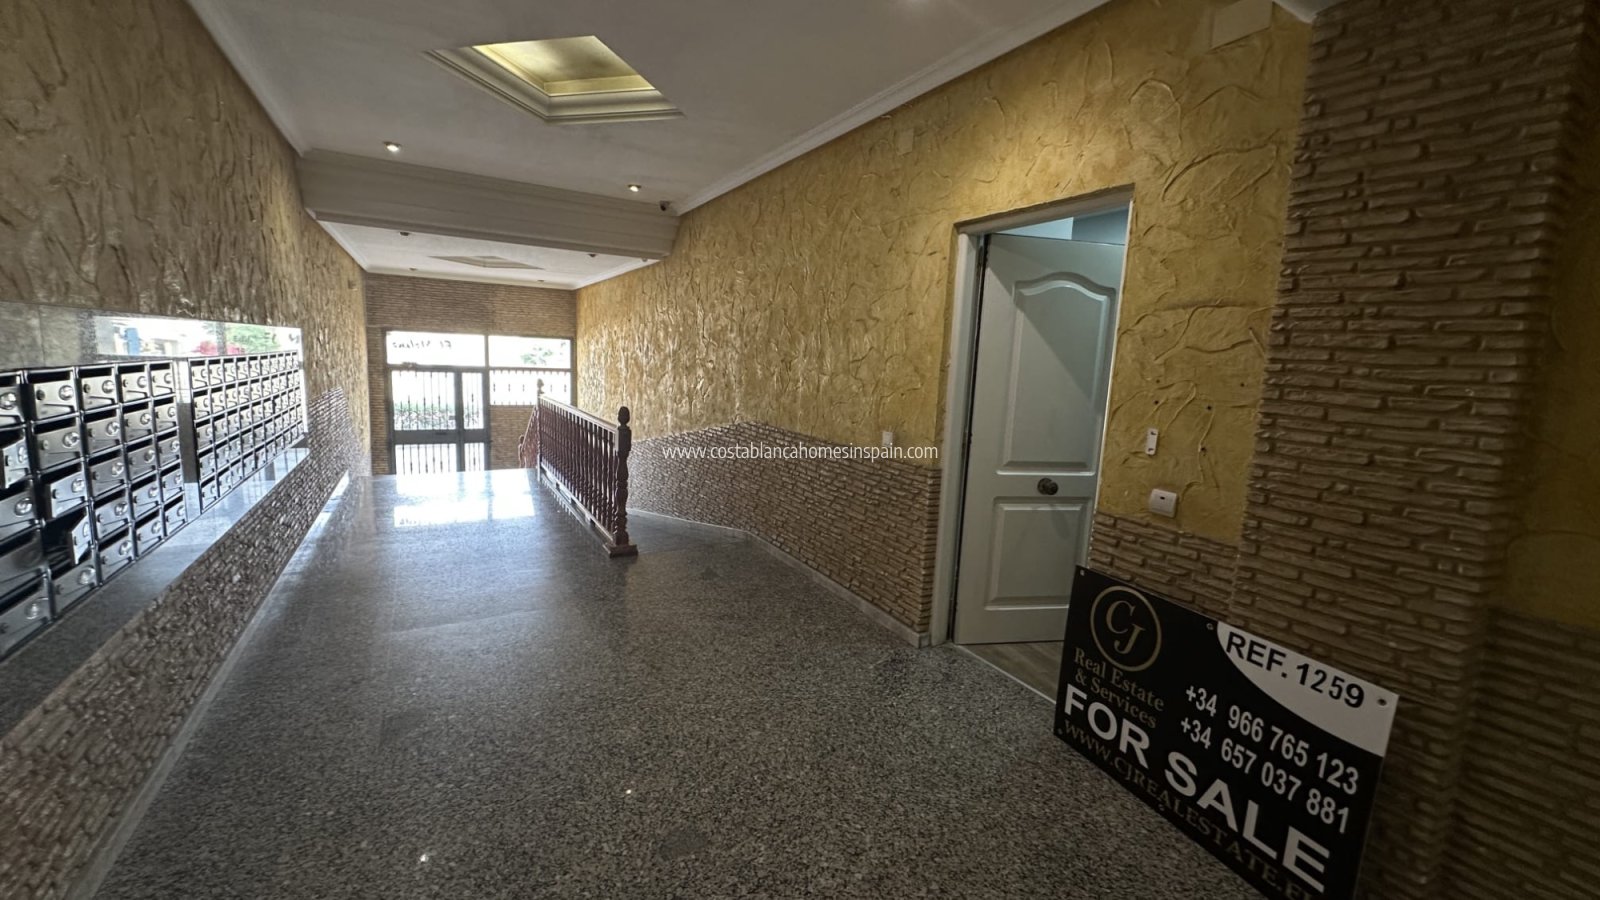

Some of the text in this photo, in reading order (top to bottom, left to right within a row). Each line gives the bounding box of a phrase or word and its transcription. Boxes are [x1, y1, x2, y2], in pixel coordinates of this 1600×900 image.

[1105, 600, 1146, 655] CJ
[1074, 646, 1165, 712] Real Estate
[1075, 667, 1157, 729] & Services
[1225, 631, 1365, 709] REF. 1259
[1180, 716, 1350, 834] +34 657 037 881
[1185, 684, 1360, 796] +34 966 765 123
[1063, 683, 1331, 894] FOR SALE
